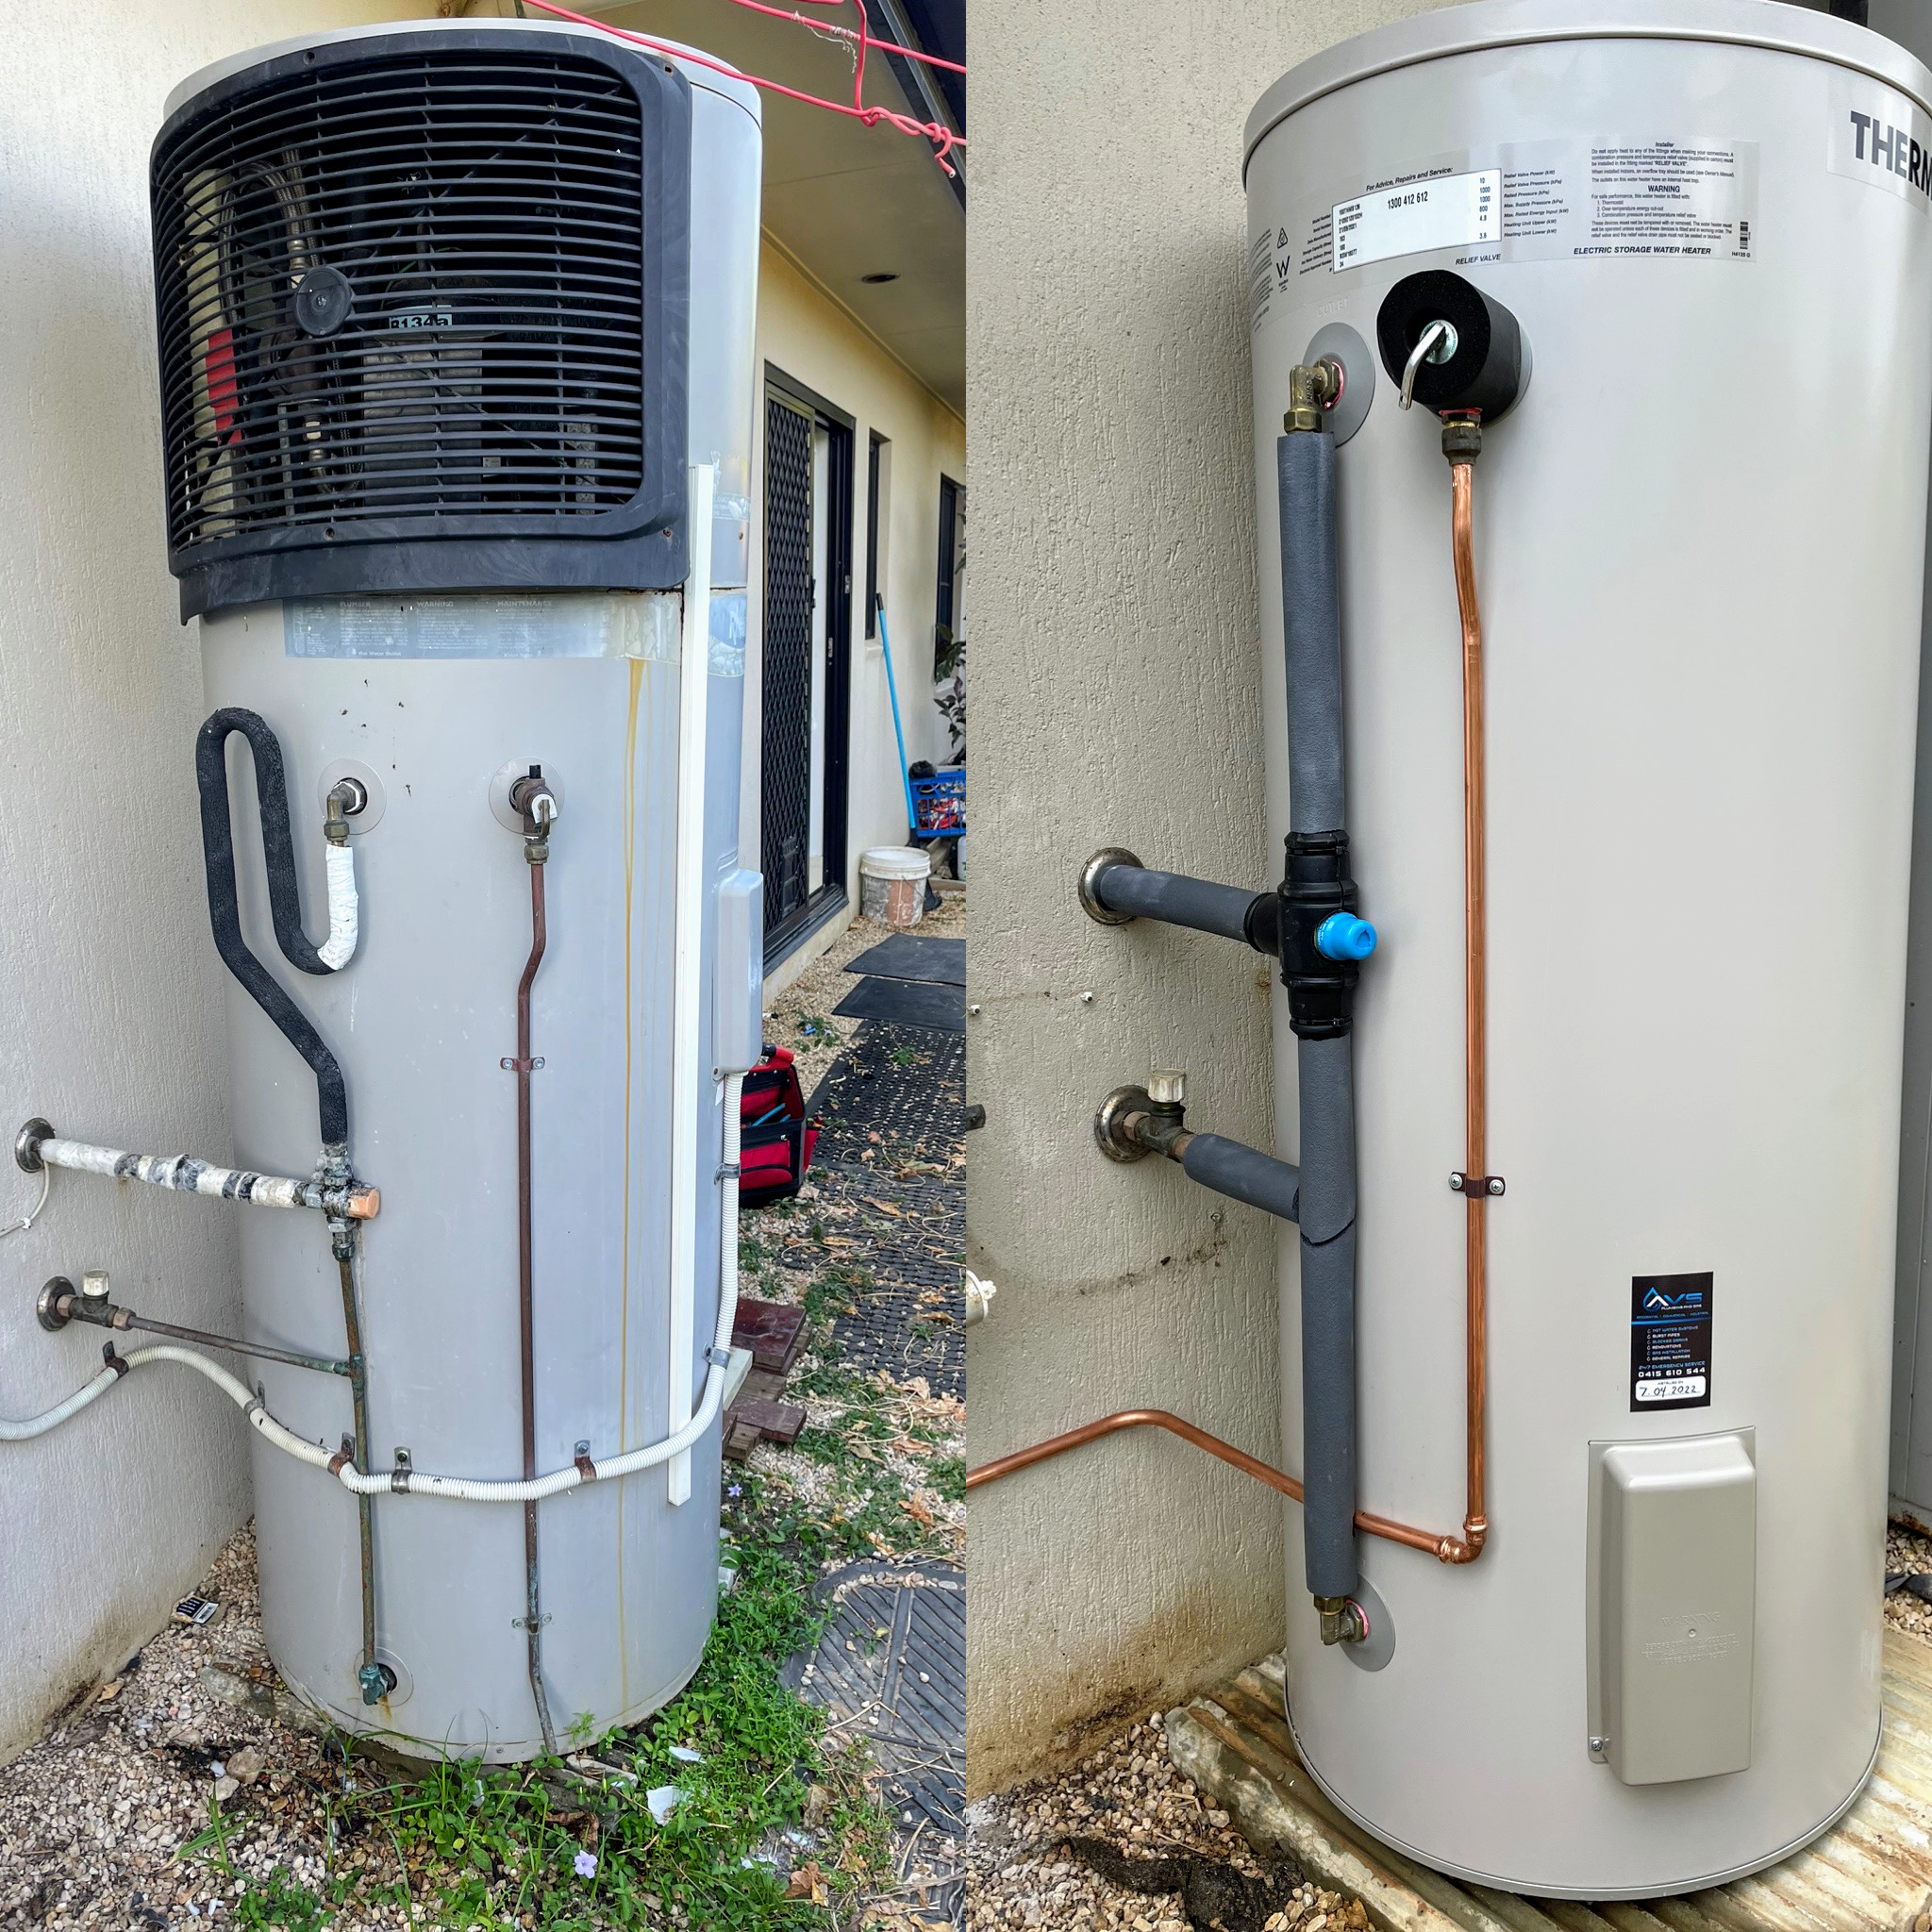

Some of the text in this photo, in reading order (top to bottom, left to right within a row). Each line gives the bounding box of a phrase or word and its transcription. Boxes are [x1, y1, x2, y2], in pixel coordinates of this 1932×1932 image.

[1375, 178, 1394, 190] Advice,
[1395, 174, 1416, 185] Repairs
[1429, 167, 1453, 176] Service:
[1387, 191, 1428, 209] 1300 412 612
[1574, 246, 1611, 255] ELECTRIC
[1681, 246, 1711, 255] HEATER
[1456, 254, 1501, 266] RELIEF VALVE
